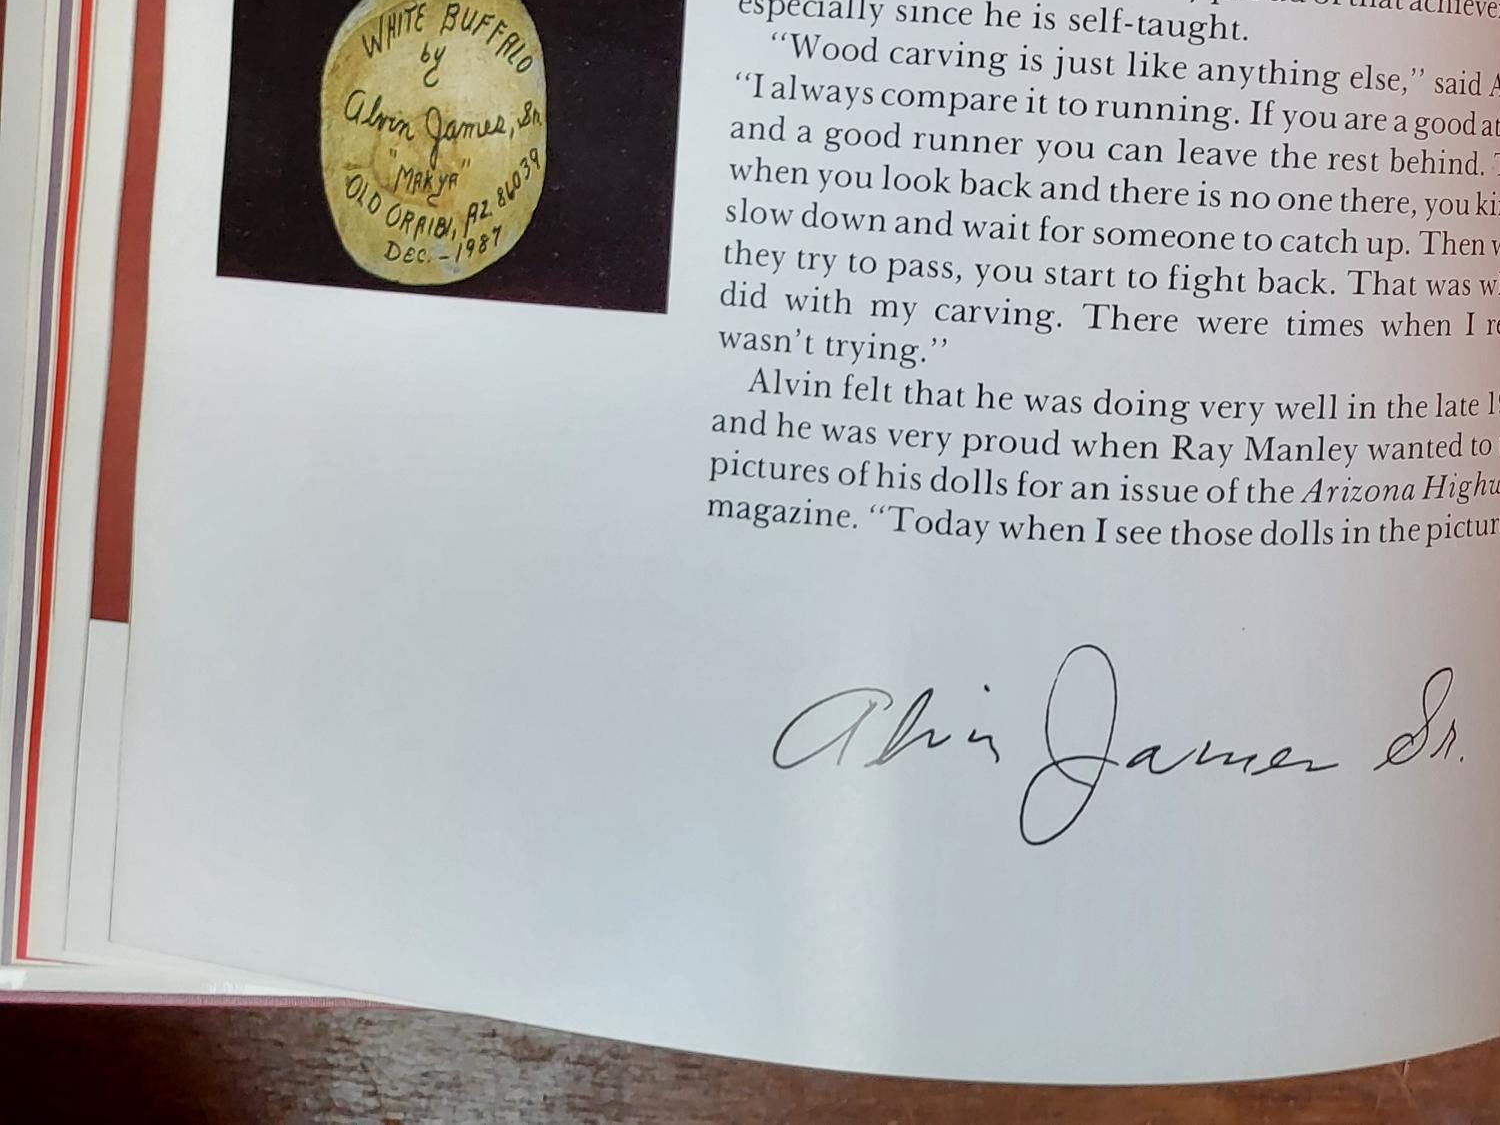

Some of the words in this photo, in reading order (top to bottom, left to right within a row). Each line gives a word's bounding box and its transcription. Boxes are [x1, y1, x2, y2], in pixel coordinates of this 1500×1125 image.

[360, 1, 428, 59] WHITE
[439, 1, 534, 75] BUFFALO
[984, 0, 1022, 29] he
[1032, 2, 1056, 31] is
[1068, 6, 1249, 47] self-taught.
[420, 41, 447, 89] by
[343, 88, 415, 142] Alvin
[729, 114, 786, 142] and
[796, 124, 813, 144] a
[823, 121, 901, 153] good
[912, 131, 1024, 156] runner
[1035, 138, 1095, 164] you
[1107, 142, 1164, 163] can
[1176, 137, 1258, 168] leave
[1270, 142, 1318, 170] the
[1327, 152, 1379, 173] rest
[1389, 146, 1485, 177] behind.
[344, 173, 383, 216] OLD
[384, 202, 458, 242] ORAIBI,
[496, 146, 542, 209] 86039
[383, 239, 432, 264] DEC.
[724, 238, 787, 275] they
[797, 249, 838, 279] try
[848, 252, 878, 275] to
[886, 257, 962, 285] pass,
[974, 263, 1033, 289] you
[1044, 264, 1116, 289] start
[1127, 268, 1158, 290] to
[1167, 263, 1247, 300] fight
[1257, 266, 1336, 296] back.
[1347, 269, 1417, 297] That
[1425, 278, 1471, 297] was
[719, 279, 768, 310] did
[784, 285, 852, 316] with
[870, 299, 918, 327] my
[934, 297, 1062, 335] carving.
[1082, 302, 1179, 333] There
[1196, 316, 1269, 336] were
[1286, 309, 1364, 338] times
[1380, 311, 1452, 337] when
[1465, 311, 1476, 337] I
[711, 408, 767, 437] and
[776, 410, 812, 440] he
[821, 423, 877, 445] was
[887, 428, 953, 457] very
[961, 428, 1061, 459] proud
[1071, 431, 1159, 460] when
[1170, 434, 1234, 469] Ray
[1243, 435, 1359, 469] Manley
[1367, 431, 1463, 461] wanted
[1471, 437, 1493, 457] to
